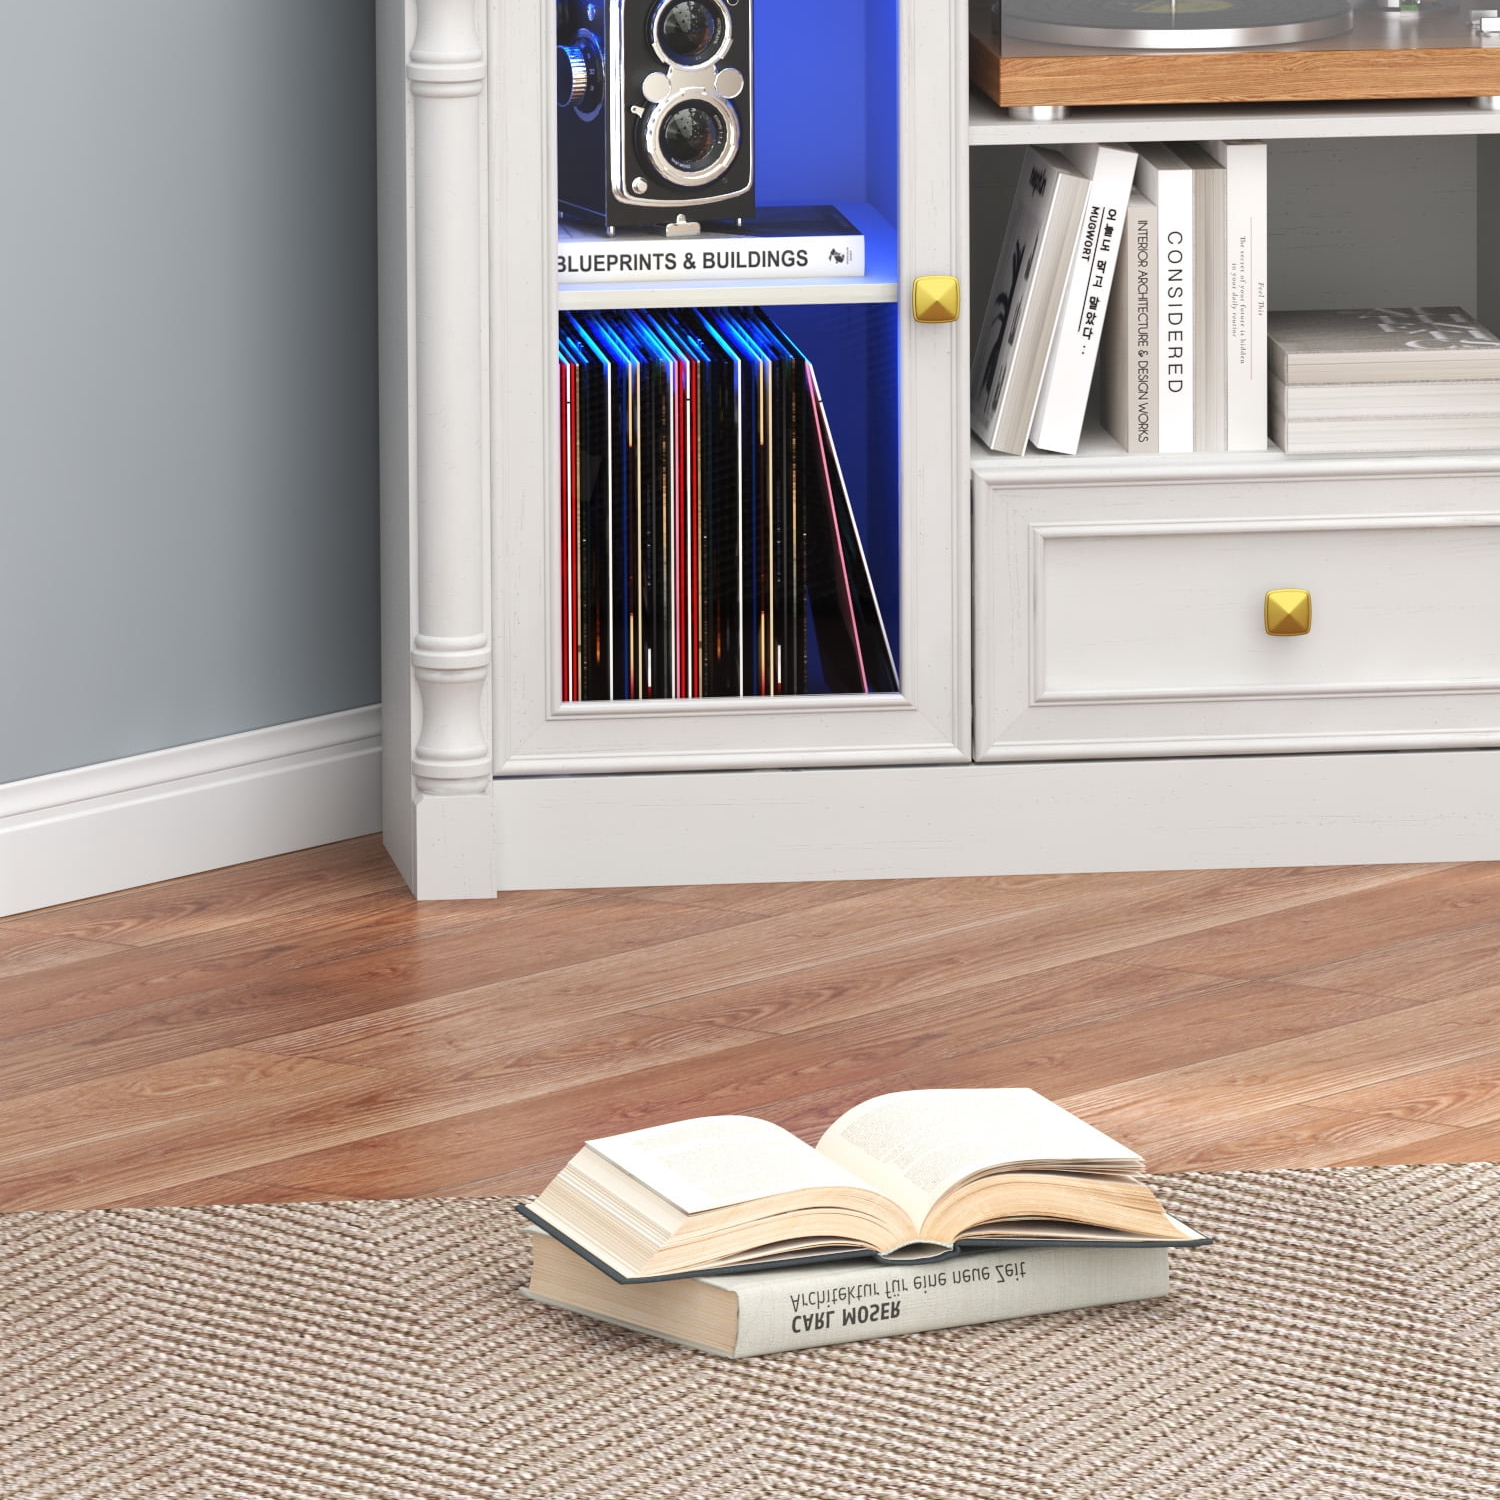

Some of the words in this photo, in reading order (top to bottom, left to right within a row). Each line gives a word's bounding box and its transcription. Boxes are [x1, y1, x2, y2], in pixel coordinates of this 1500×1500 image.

[1081, 206, 1100, 262] MUGWORT
[1137, 220, 1149, 267] INTERIOR
[558, 252, 677, 273] BLUEPRINTS
[683, 252, 697, 270] &
[702, 249, 808, 269] BUILDINGS
[1137, 269, 1149, 347] ARCHITECTURE
[1167, 231, 1184, 393] CONSIDERED
[1257, 302, 1265, 316] This
[1138, 350, 1149, 358] &
[1138, 361, 1149, 400] DESIGN
[1138, 403, 1149, 443] WORKS
